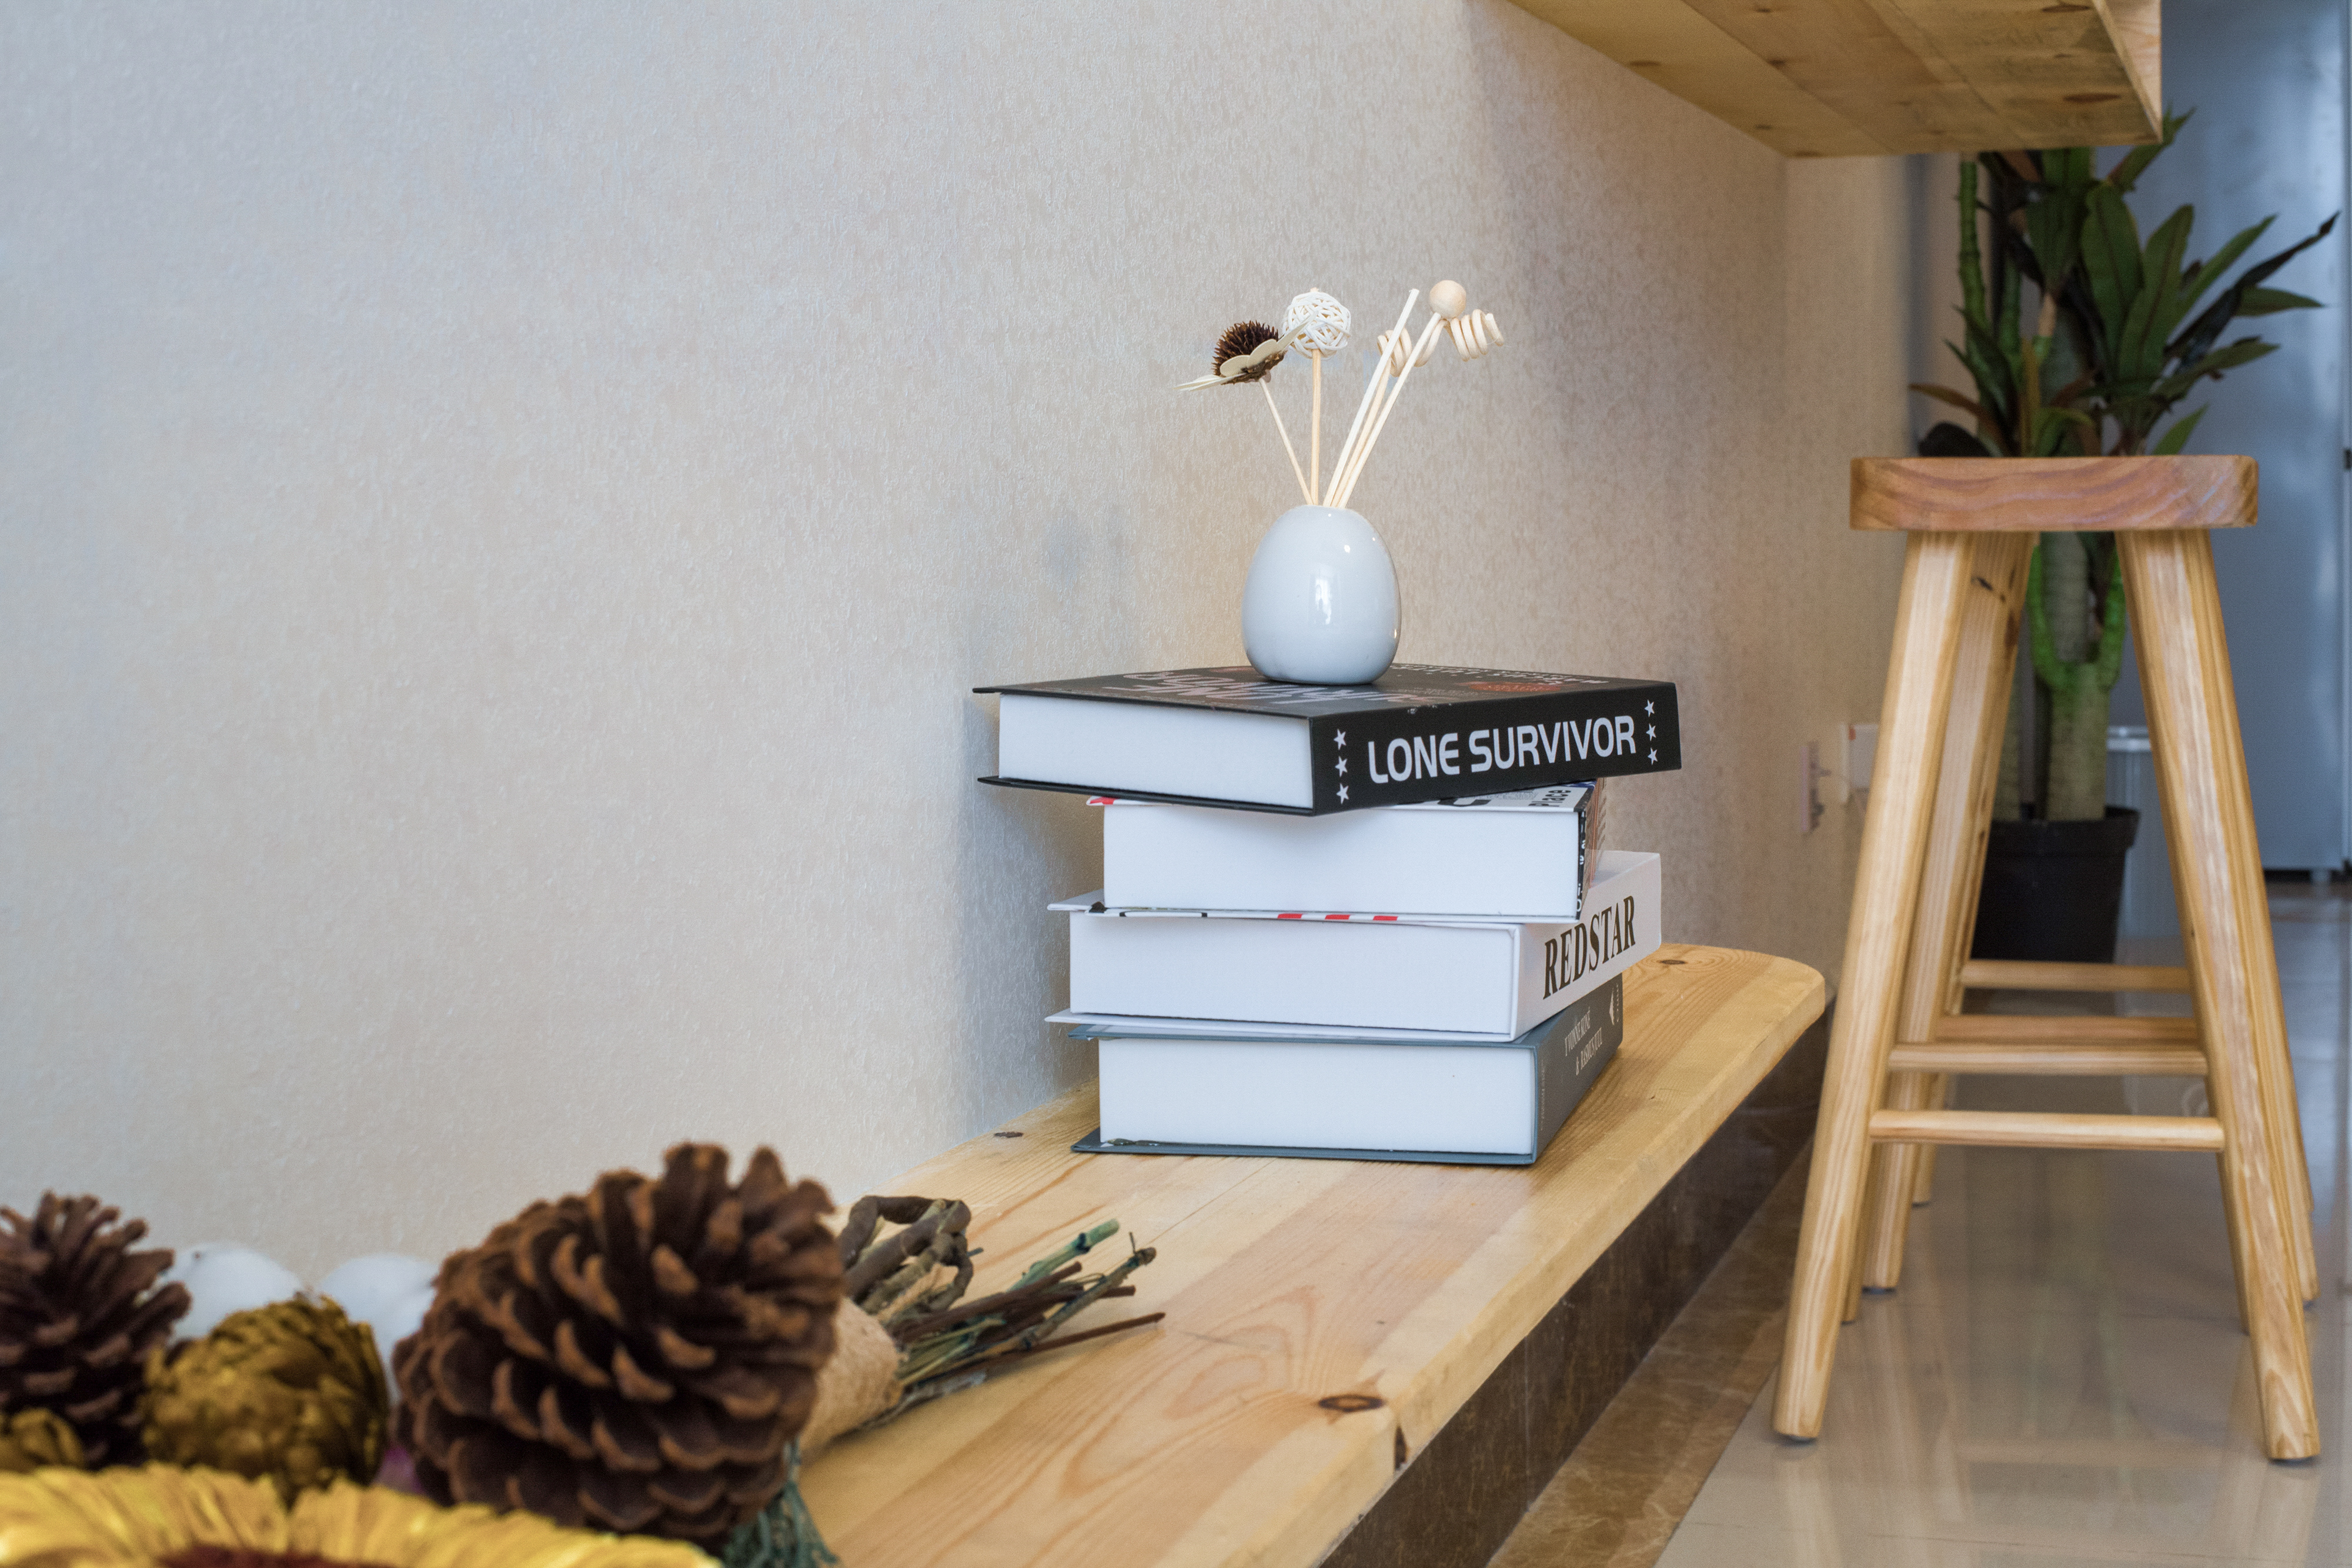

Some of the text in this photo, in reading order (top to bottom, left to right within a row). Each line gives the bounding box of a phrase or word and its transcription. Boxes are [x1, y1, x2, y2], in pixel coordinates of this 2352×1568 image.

[1368, 715, 1636, 784] LONE SURVIVOR
[1543, 895, 1636, 1000] REDSTAR
